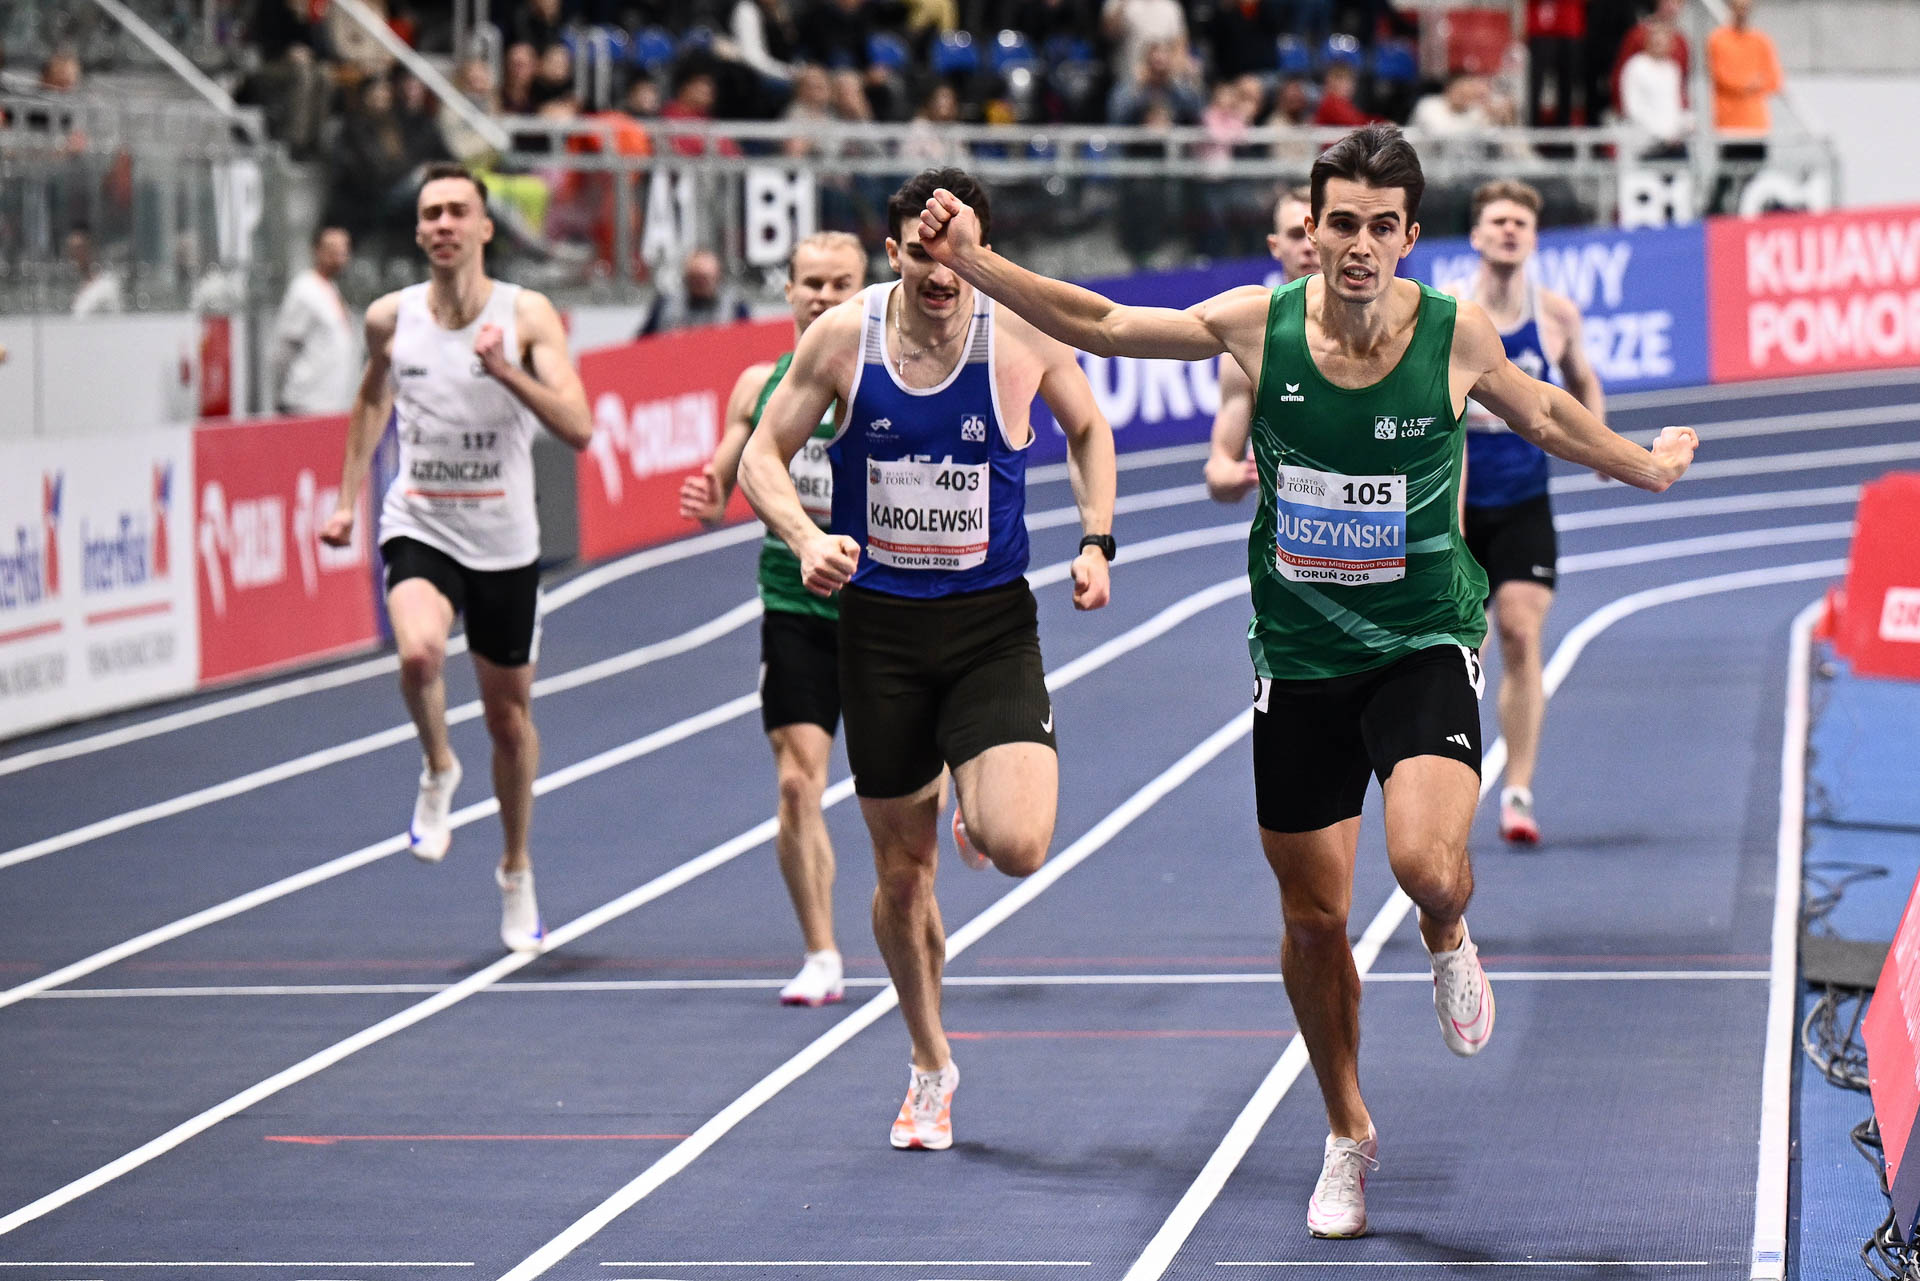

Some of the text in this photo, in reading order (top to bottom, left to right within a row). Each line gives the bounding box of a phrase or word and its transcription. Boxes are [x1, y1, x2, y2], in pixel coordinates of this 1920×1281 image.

[746, 165, 815, 266] B1
[1281, 393, 1304, 402] erima
[935, 470, 980, 491] 403
[1289, 477, 1318, 485] MIASTO
[1287, 482, 1326, 496] TORUŃ
[1342, 483, 1392, 505] 105
[870, 502, 983, 533] KAROLEWSKI
[892, 555, 960, 566] TORUŃ 2026
[1298, 557, 1327, 567] Halowe
[1328, 560, 1375, 570] Mistrzostwa
[1376, 559, 1400, 568] Polski
[1294, 569, 1370, 582] TORUŃ 2026
